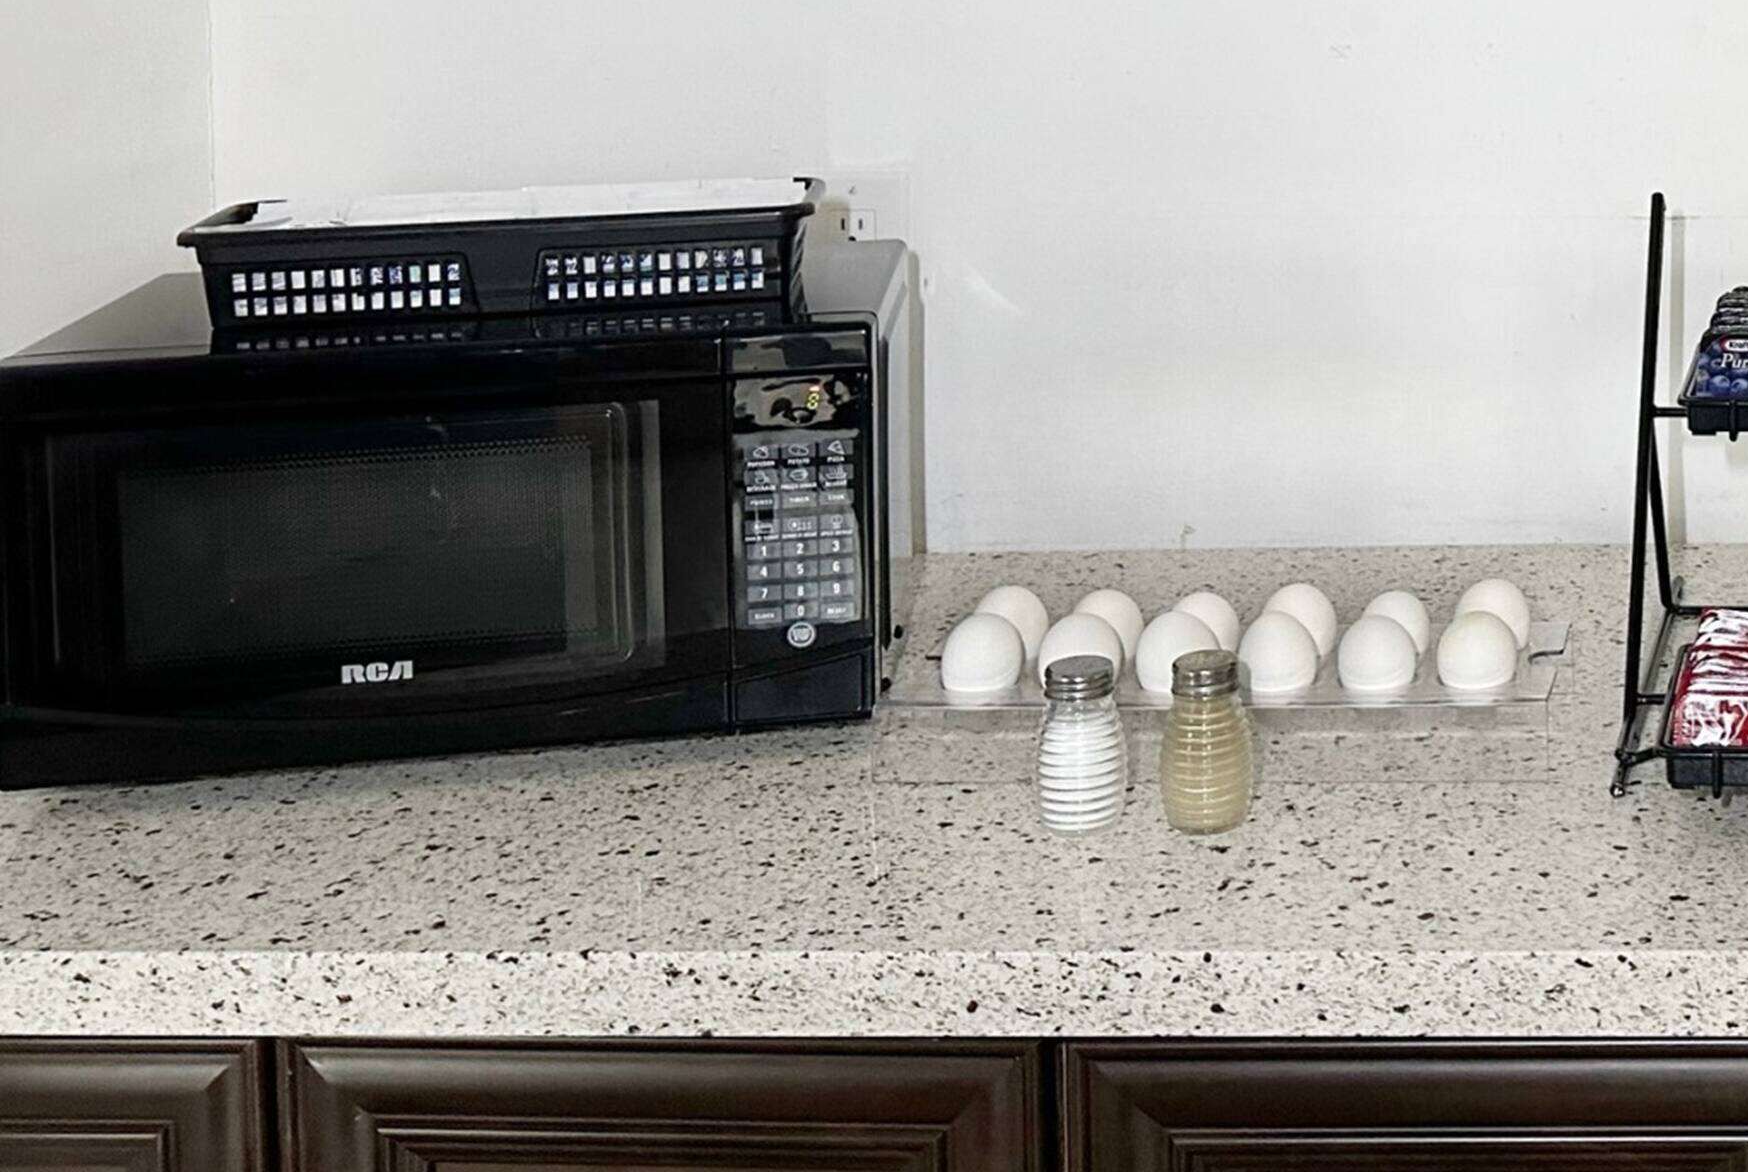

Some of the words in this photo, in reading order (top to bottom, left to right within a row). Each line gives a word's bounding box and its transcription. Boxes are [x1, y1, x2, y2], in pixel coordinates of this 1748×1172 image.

[761, 545, 767, 556] 1
[796, 543, 805, 554] 2
[832, 541, 840, 552] 3
[760, 566, 768, 578] 4
[796, 564, 805, 575] 5
[832, 561, 840, 572] 6
[761, 588, 769, 599] 7
[797, 585, 805, 597] 8
[833, 583, 841, 594] 9
[797, 605, 805, 616] 0
[340, 659, 414, 685] RCA
